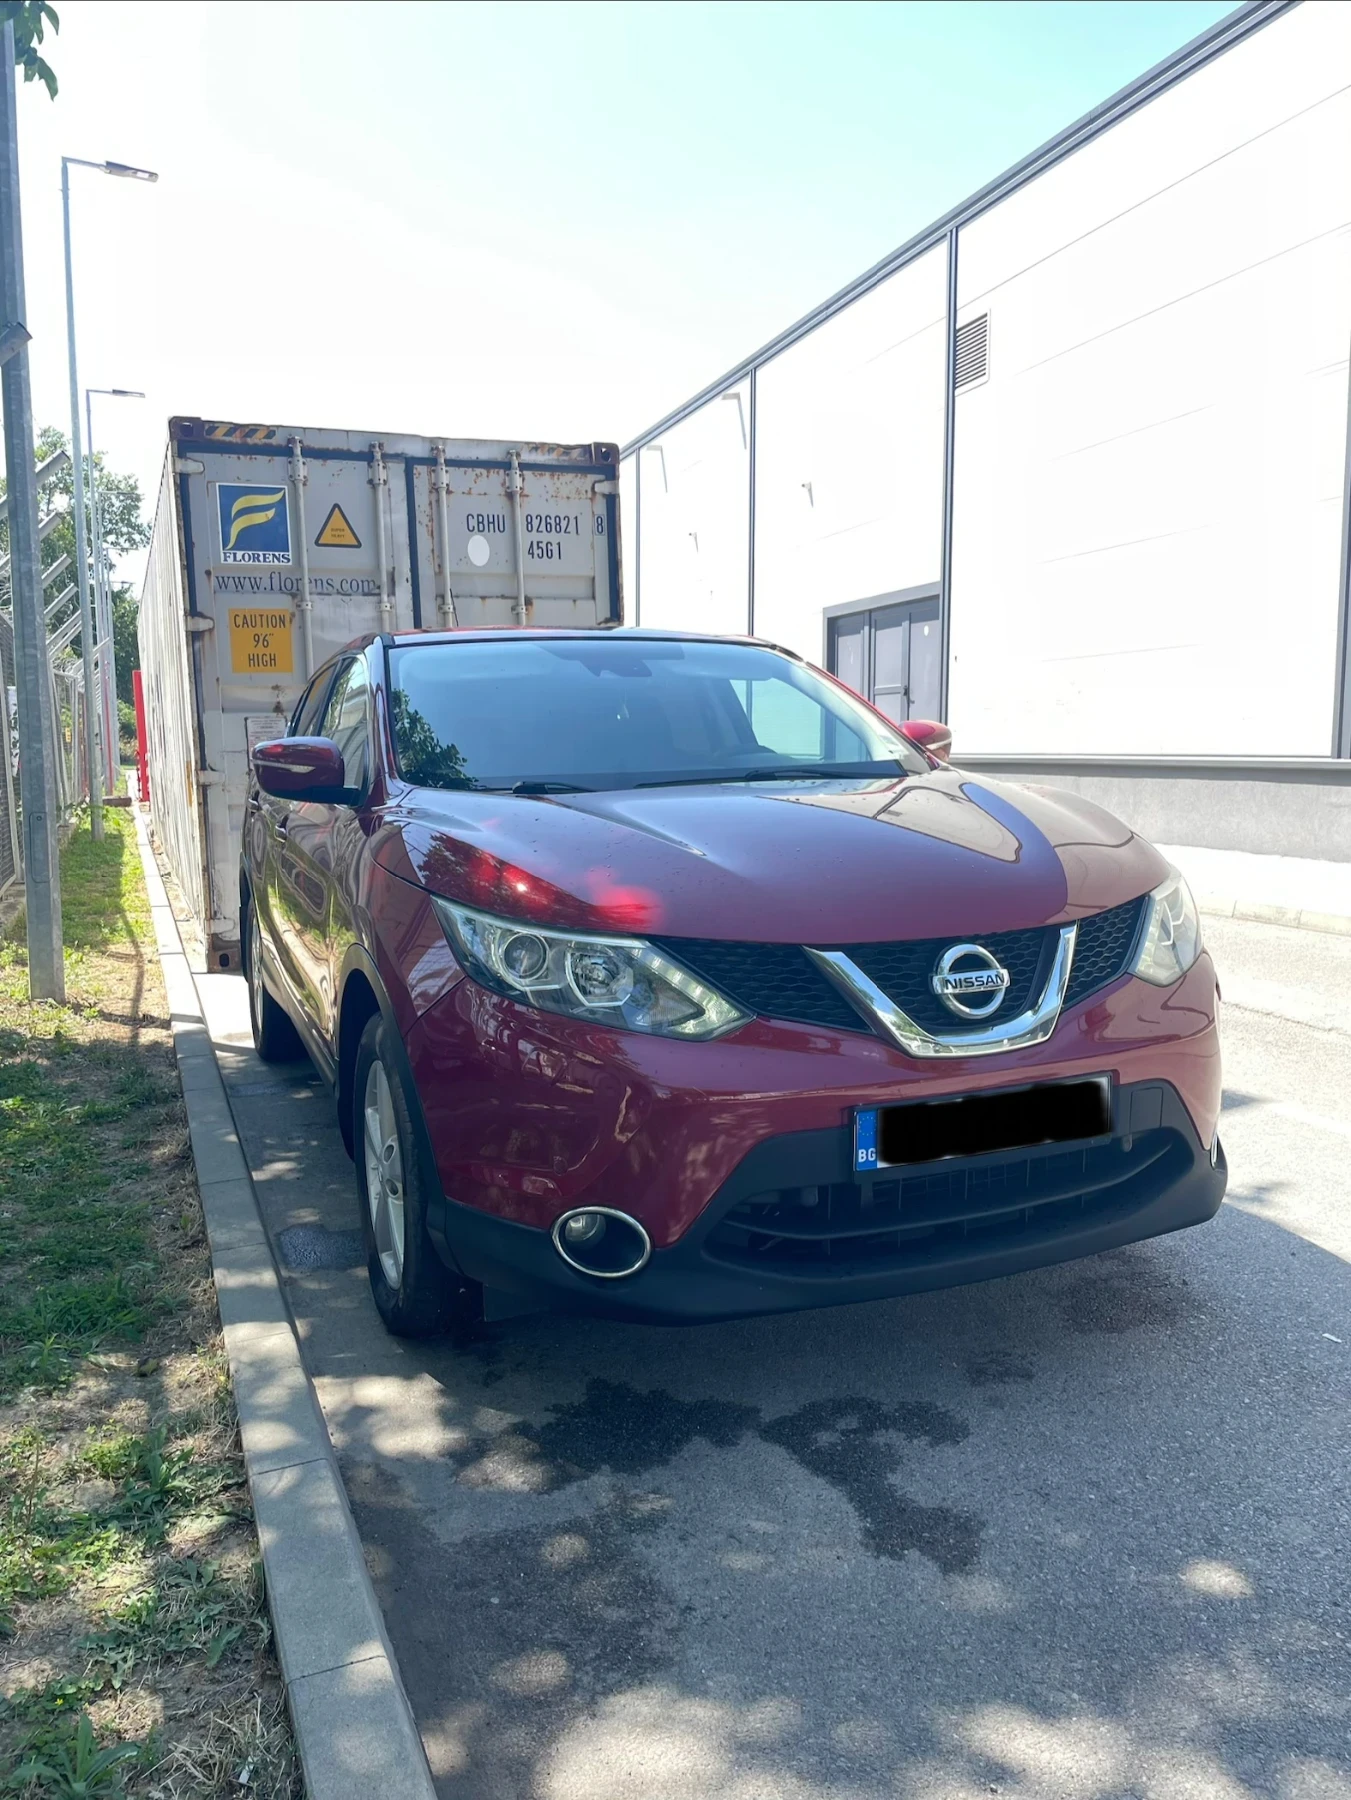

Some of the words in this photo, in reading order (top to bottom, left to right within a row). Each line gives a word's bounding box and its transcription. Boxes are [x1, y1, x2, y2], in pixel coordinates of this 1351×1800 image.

[466, 513, 506, 533] CBHU
[525, 514, 580, 535] 826821
[596, 515, 604, 534] 8
[222, 551, 291, 564] FLORENS
[527, 540, 562, 560] 45G1
[233, 613, 286, 628] CAUTION
[248, 653, 277, 668] HIGH
[944, 973, 1005, 990] NISSAN
[858, 1147, 876, 1163] BG
